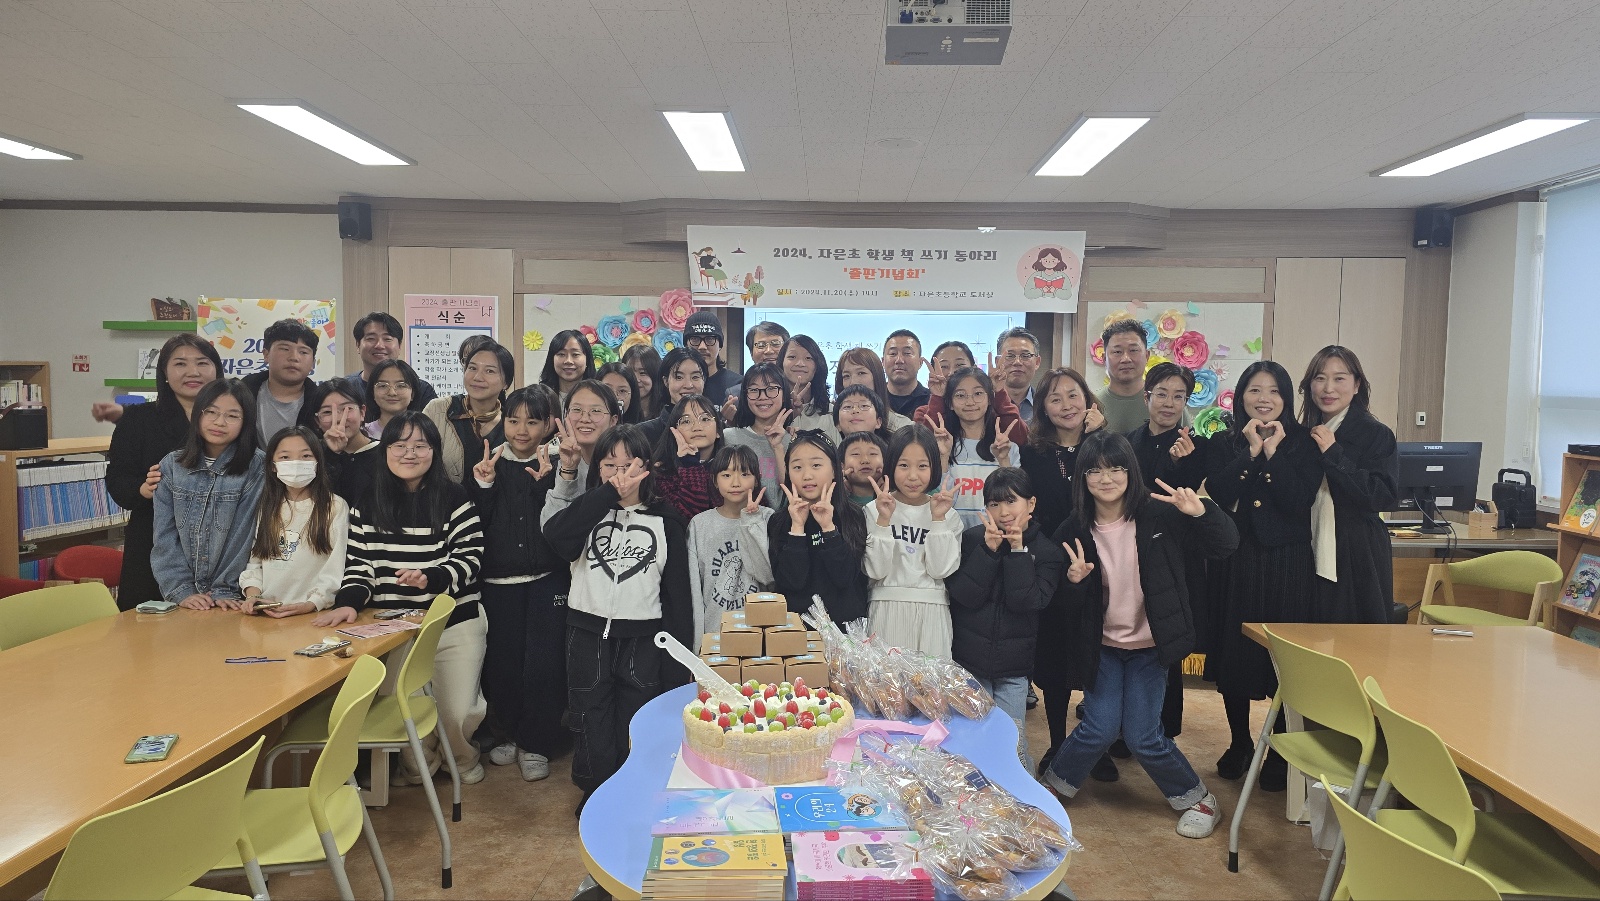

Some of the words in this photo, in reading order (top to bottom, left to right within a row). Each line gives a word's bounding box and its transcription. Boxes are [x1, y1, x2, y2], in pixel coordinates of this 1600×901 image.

[773, 247, 813, 259] 2024.
[817, 248, 861, 261] 자은초
[866, 248, 895, 261] 학생
[900, 248, 914, 262] 책
[920, 249, 949, 261] 쓰기
[954, 250, 998, 262] 동아리
[890, 524, 931, 545] LEVE
[711, 539, 740, 577] GUAR
